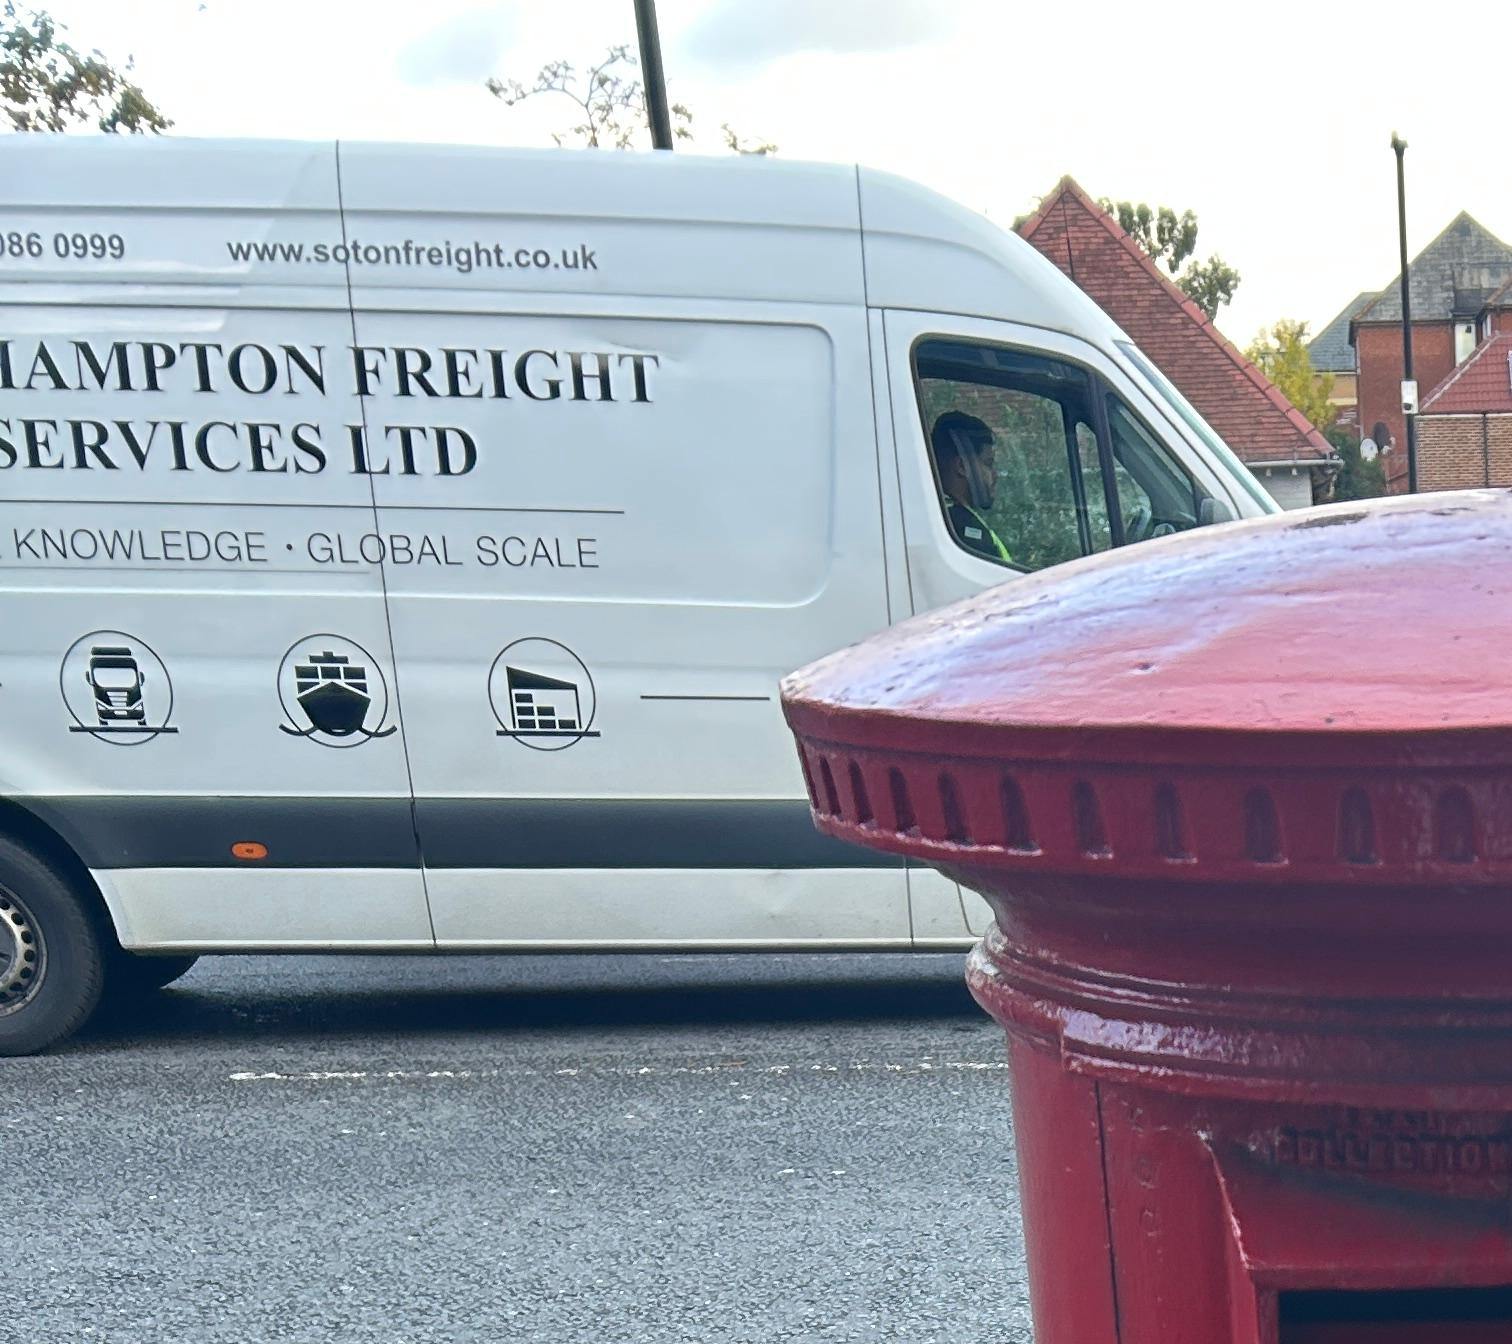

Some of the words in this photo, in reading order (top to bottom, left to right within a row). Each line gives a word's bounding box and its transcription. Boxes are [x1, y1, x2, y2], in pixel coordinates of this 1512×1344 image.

[53, 233, 125, 259] 0999
[226, 239, 598, 274] www.sotonfreight.co.uk
[348, 345, 660, 403] FREIGHT
[0, 418, 328, 476] SERVICES
[347, 424, 479, 476] LTD
[14, 528, 269, 563] KNOWLEDGE
[306, 532, 464, 567] GLOBAL
[476, 536, 600, 569] SCALE
